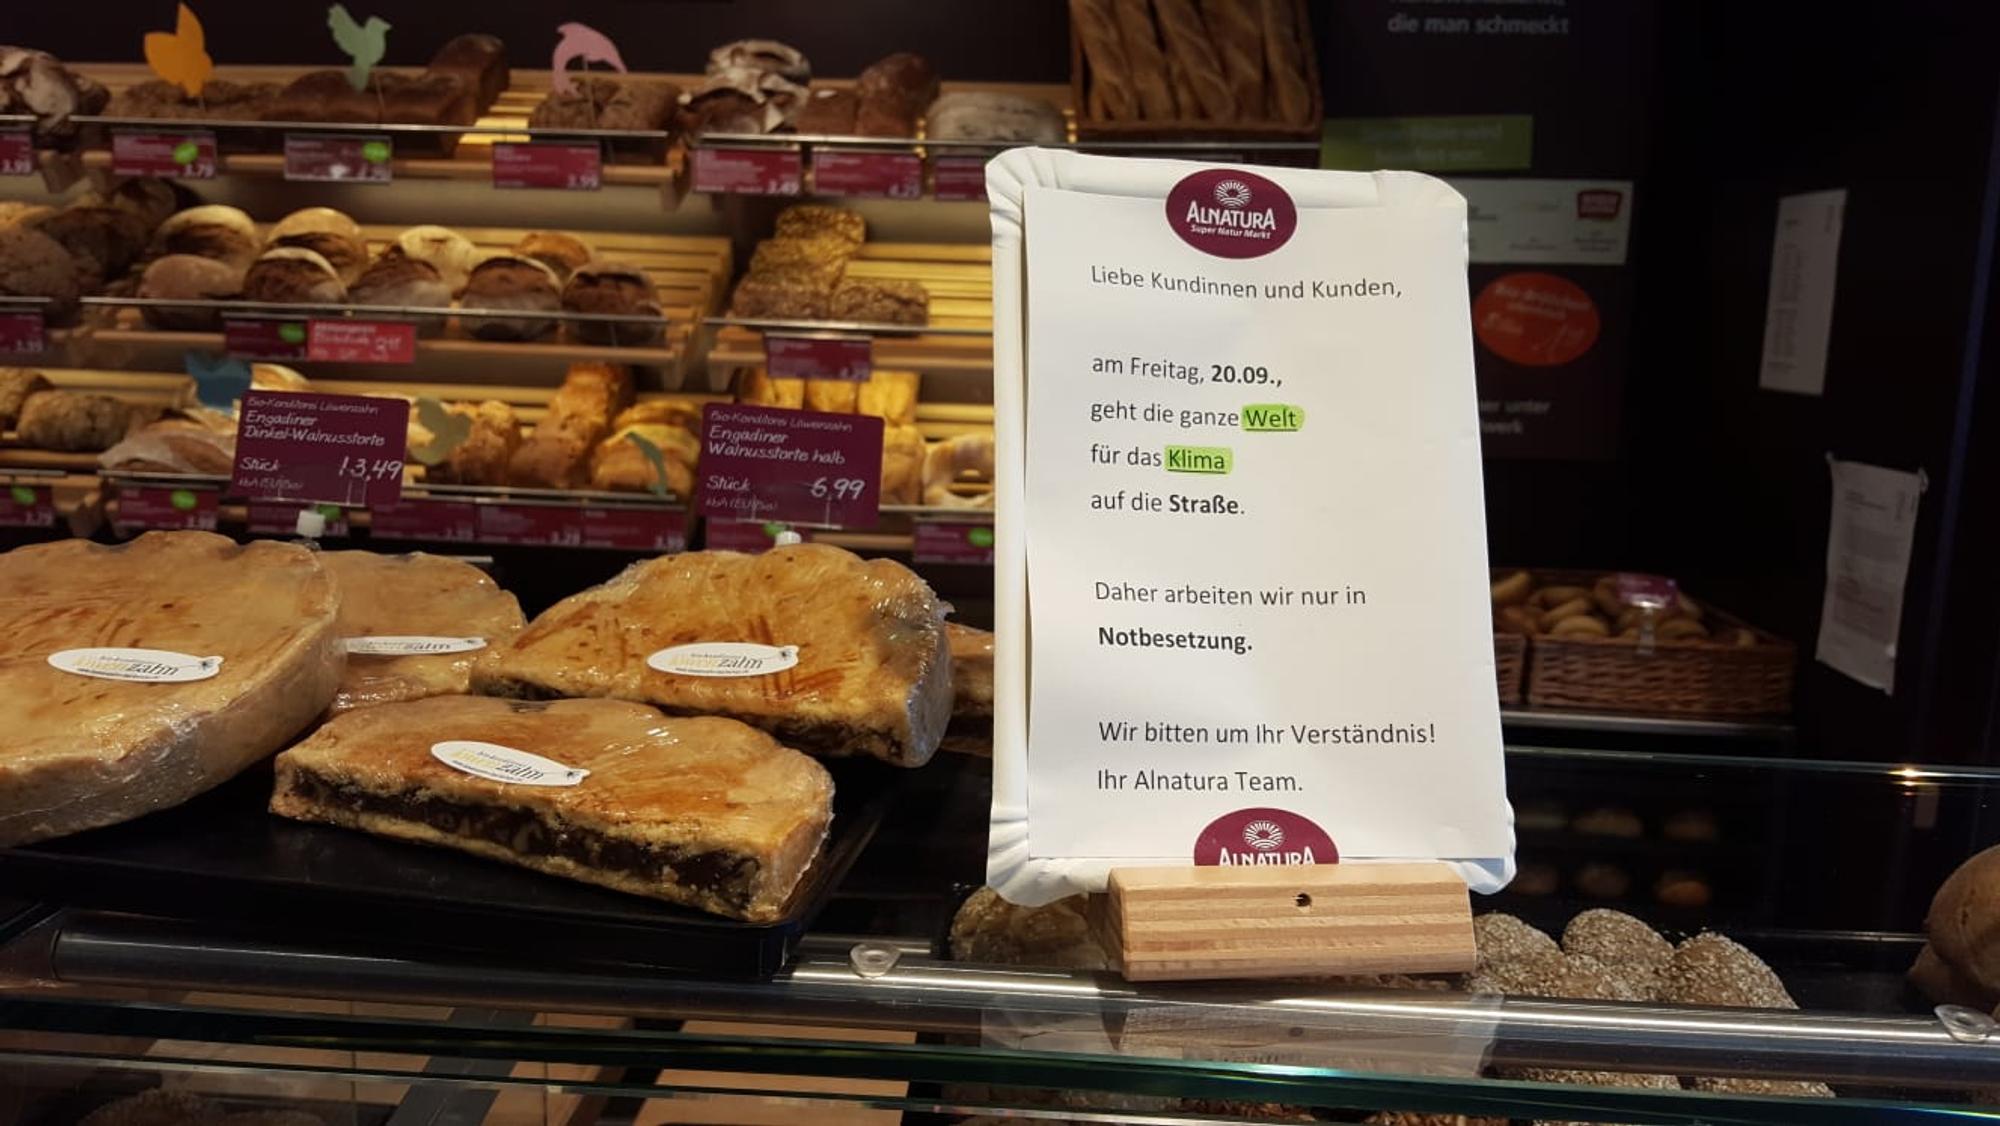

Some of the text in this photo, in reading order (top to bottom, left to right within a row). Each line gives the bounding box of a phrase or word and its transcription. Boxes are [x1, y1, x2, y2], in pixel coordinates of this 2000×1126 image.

[1387, 13, 1568, 33] die man schmeckt
[1186, 200, 1276, 231] ALNATURA
[1190, 224, 1271, 240] Super Natur Markt
[1091, 265, 1402, 299] Liebe Kundinnen und Kunden,
[1092, 356, 1283, 388] am Freitag, 20.09.,
[245, 410, 318, 426] Engadiner
[1090, 399, 1296, 429] geht die ganze Welt
[244, 425, 386, 447] Dinkel-Walnusstorte
[709, 425, 789, 444] Engadiner
[1481, 419, 1524, 434] werk
[708, 441, 846, 465] Walnusstorte halb
[1090, 443, 1225, 470] für das Klima
[239, 456, 403, 482] Stück 13,49
[706, 475, 751, 492] Stück
[1090, 490, 1245, 515] auf die Straße.
[1095, 581, 1367, 606] Daher arbeiten wir nur in
[1098, 626, 1253, 656] Notbesetzung.
[1098, 721, 1435, 745] Wir bitten um Ihr Verständnis!
[1098, 768, 1303, 792] Ihr Alnatura Team.
